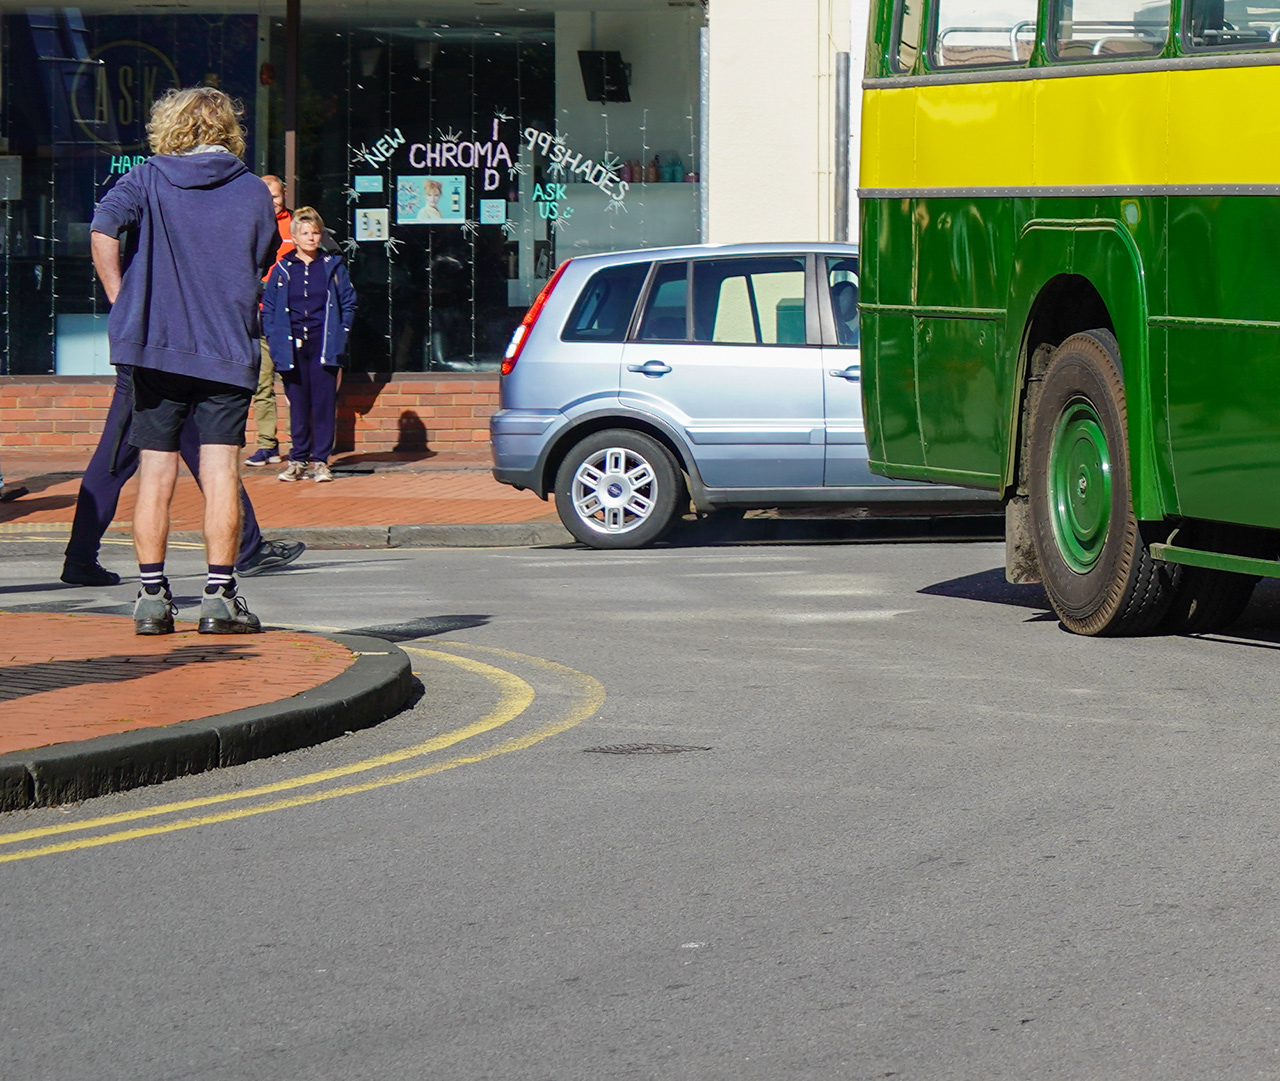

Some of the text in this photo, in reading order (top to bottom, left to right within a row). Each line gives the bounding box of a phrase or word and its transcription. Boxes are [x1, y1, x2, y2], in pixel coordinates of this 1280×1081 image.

[362, 127, 407, 169] NEW
[532, 182, 568, 202] ASK
[538, 201, 559, 220] US
